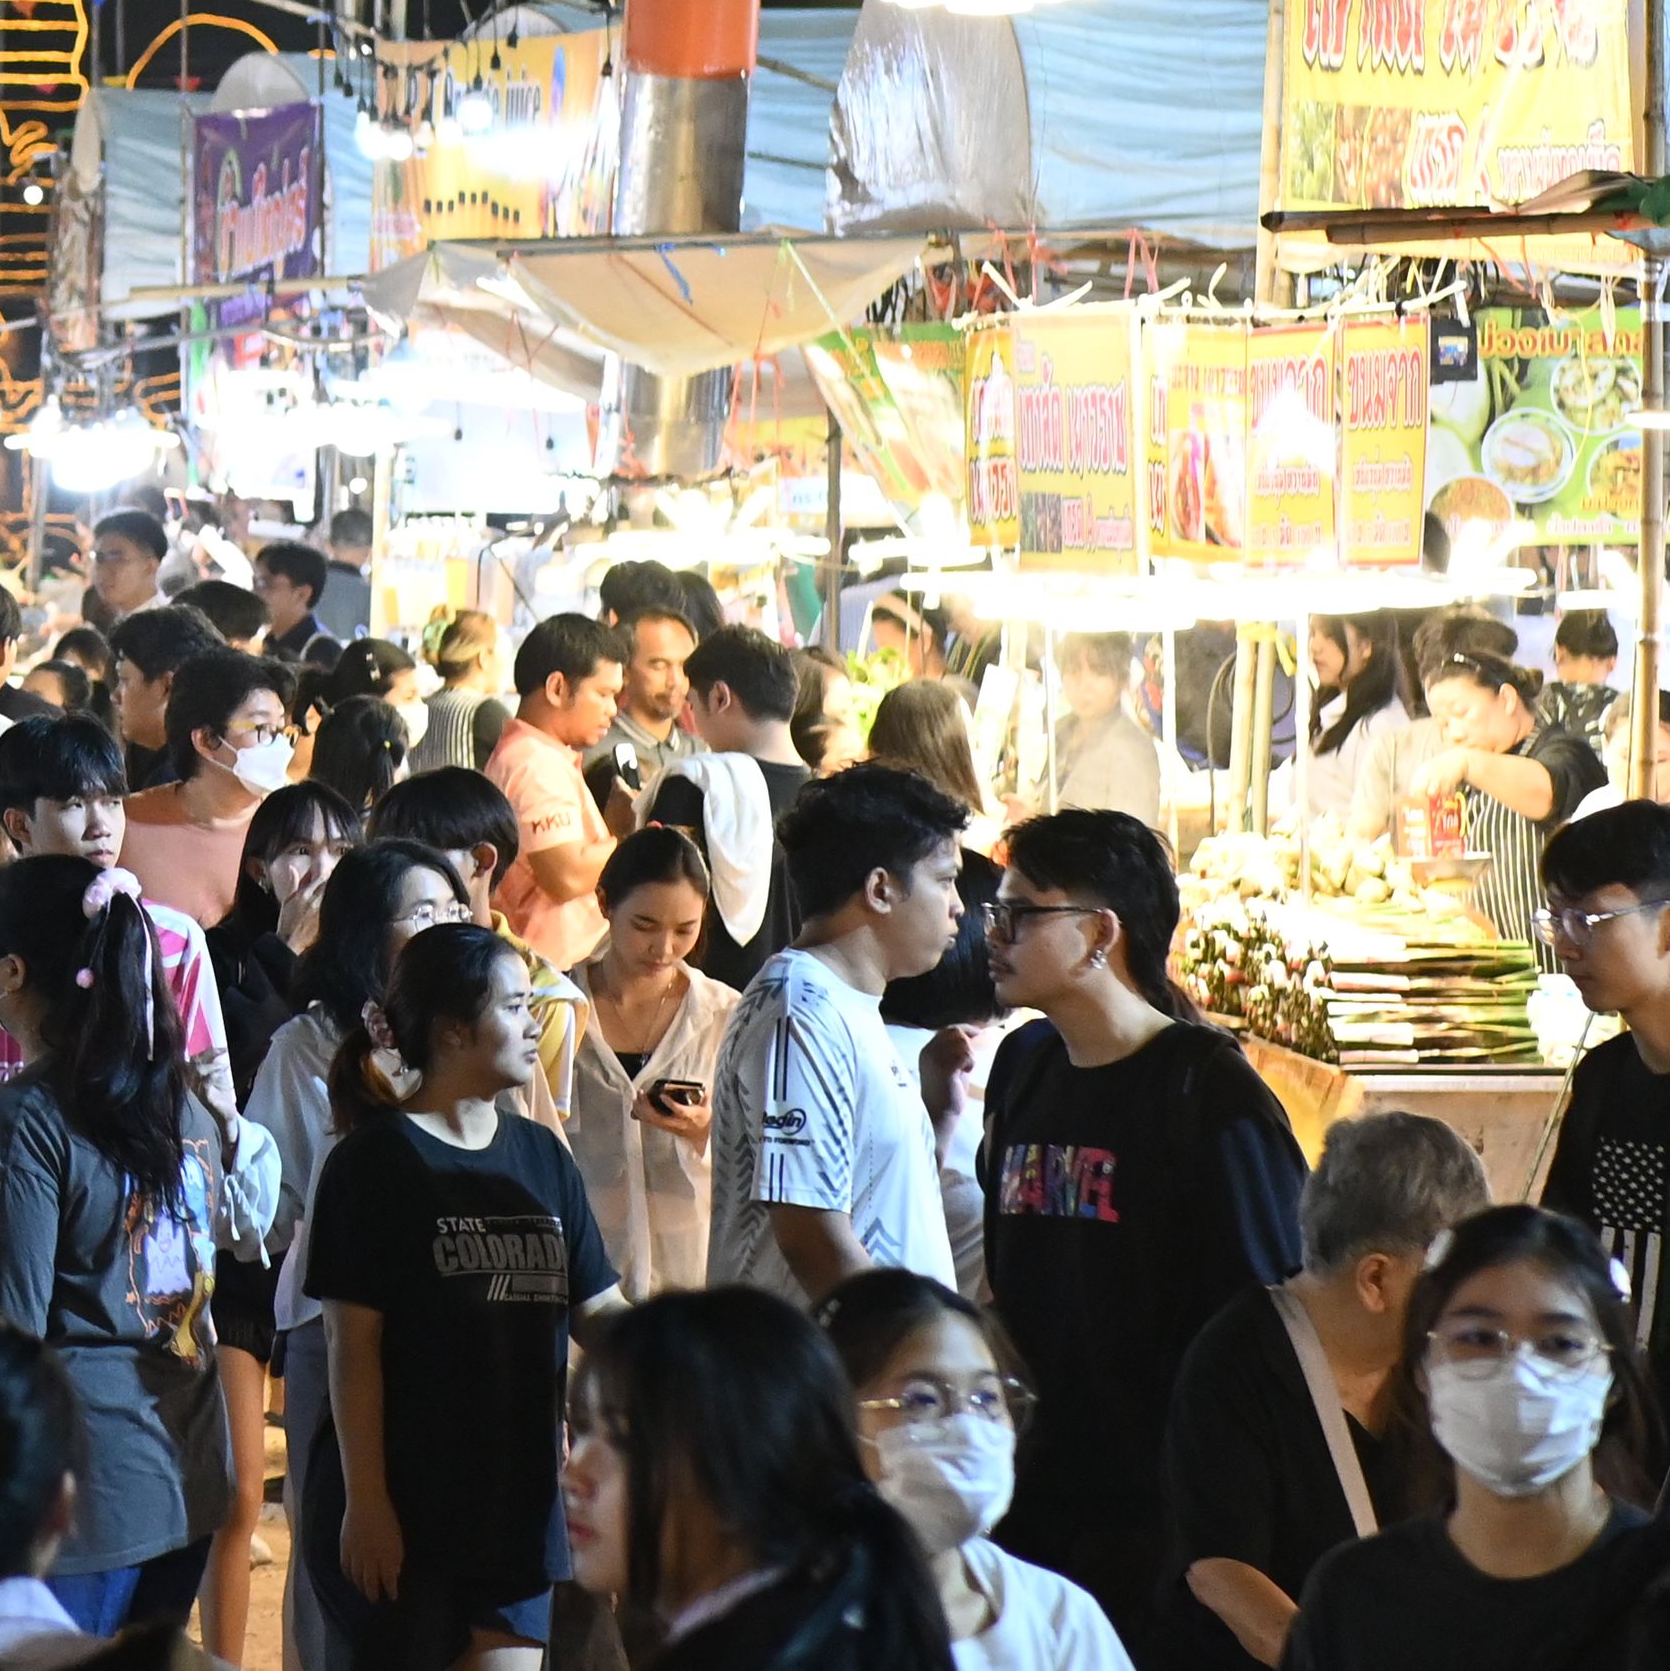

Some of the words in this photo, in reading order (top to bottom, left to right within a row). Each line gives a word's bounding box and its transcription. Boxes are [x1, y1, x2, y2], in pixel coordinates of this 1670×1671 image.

[1346, 346, 1423, 430] ขนมจาก
[531, 813, 571, 834] KKU
[437, 1217, 486, 1234] STATE
[433, 1233, 568, 1273] COLORAD
